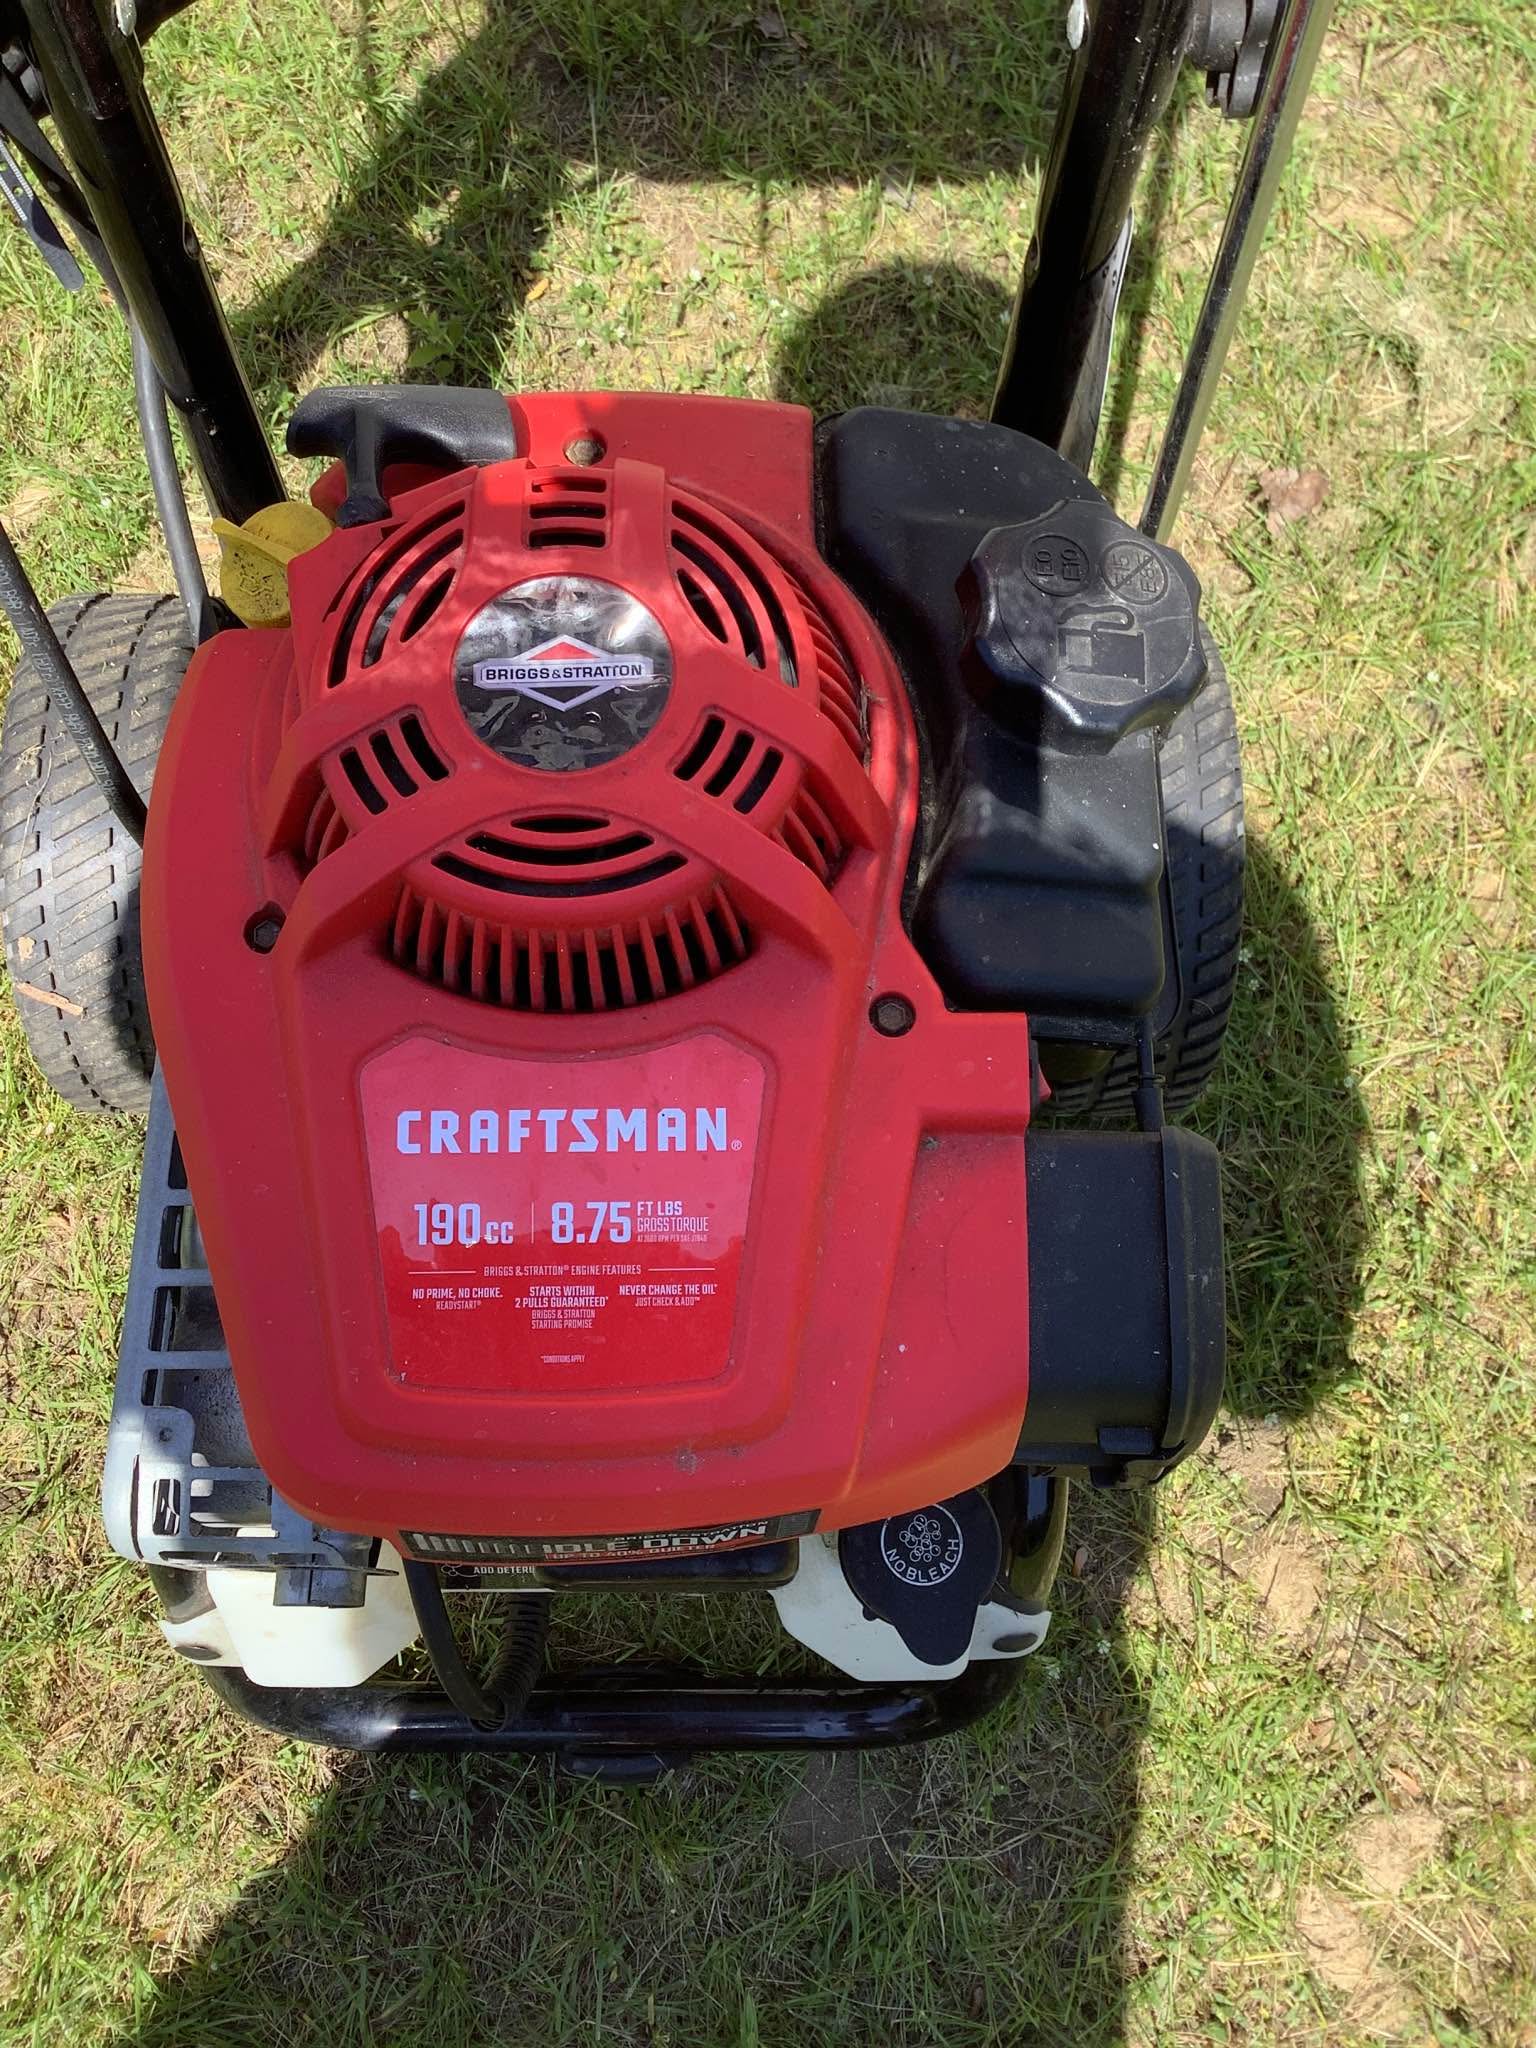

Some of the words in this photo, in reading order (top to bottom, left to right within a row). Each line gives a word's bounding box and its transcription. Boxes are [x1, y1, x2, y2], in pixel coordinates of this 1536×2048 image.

[637, 1201, 654, 1216] FT
[657, 1201, 682, 1216] LBS
[551, 1201, 632, 1244] 8.75
[637, 1217, 669, 1233] GROSS
[670, 1216, 709, 1232] TORQUE
[483, 1266, 514, 1277] BRIGGS
[571, 1265, 600, 1276] ENGINE
[602, 1264, 641, 1275] FEATURES
[412, 1288, 424, 1299] NO
[426, 1288, 456, 1300] PRIME,
[458, 1288, 470, 1298] NO
[472, 1287, 503, 1298] CHOKE.
[529, 1286, 561, 1297] STARTS
[563, 1286, 595, 1296] WITHIN
[620, 1284, 647, 1295] NEVER
[648, 1284, 682, 1295] CHANGE
[684, 1284, 700, 1295] THE
[515, 1299, 520, 1308] 2
[522, 1298, 549, 1308] PULLS
[635, 1297, 651, 1307] JUST
[652, 1297, 673, 1306] CHECK
[532, 1310, 556, 1319] BRIGGS
[564, 1309, 595, 1318] STRATTON
[531, 1320, 562, 1329] STARTING
[563, 1319, 592, 1328] PROMISE
[542, 1540, 631, 1555] IDLE
[642, 1525, 767, 1550] DOWN
[473, 1566, 494, 1574] ADD
